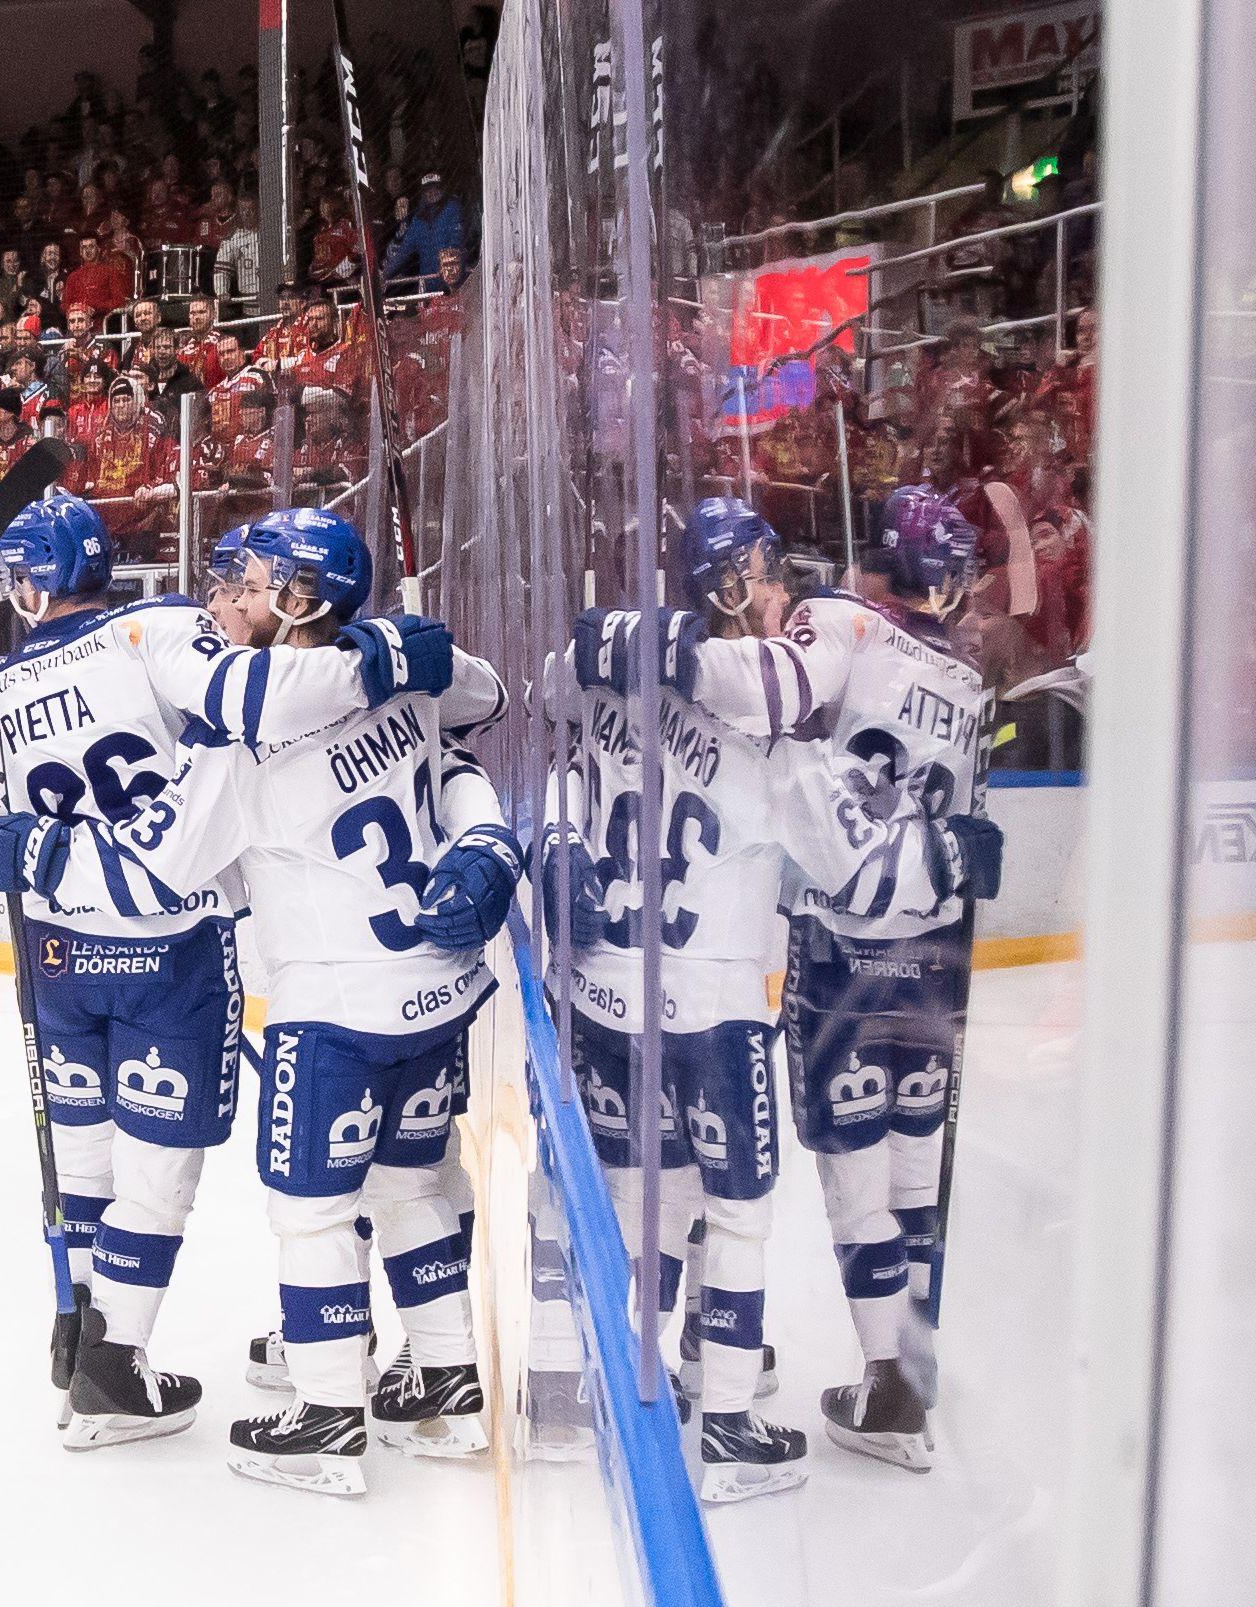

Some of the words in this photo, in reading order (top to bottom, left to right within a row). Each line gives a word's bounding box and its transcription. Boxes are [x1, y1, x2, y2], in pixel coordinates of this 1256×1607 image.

[83, 537, 101, 556] 86
[30, 563, 57, 574] CCM
[326, 571, 356, 586] CCM
[20, 632, 109, 682] Sparbank
[0, 685, 96, 755] PIETTA
[325, 703, 426, 794] ÖHMAN
[74, 954, 161, 974] DÖRREN
[401, 984, 453, 1021] clas
[23, 1022, 47, 1128] RIBCORE
[115, 1095, 185, 1122] MOSKOGEN
